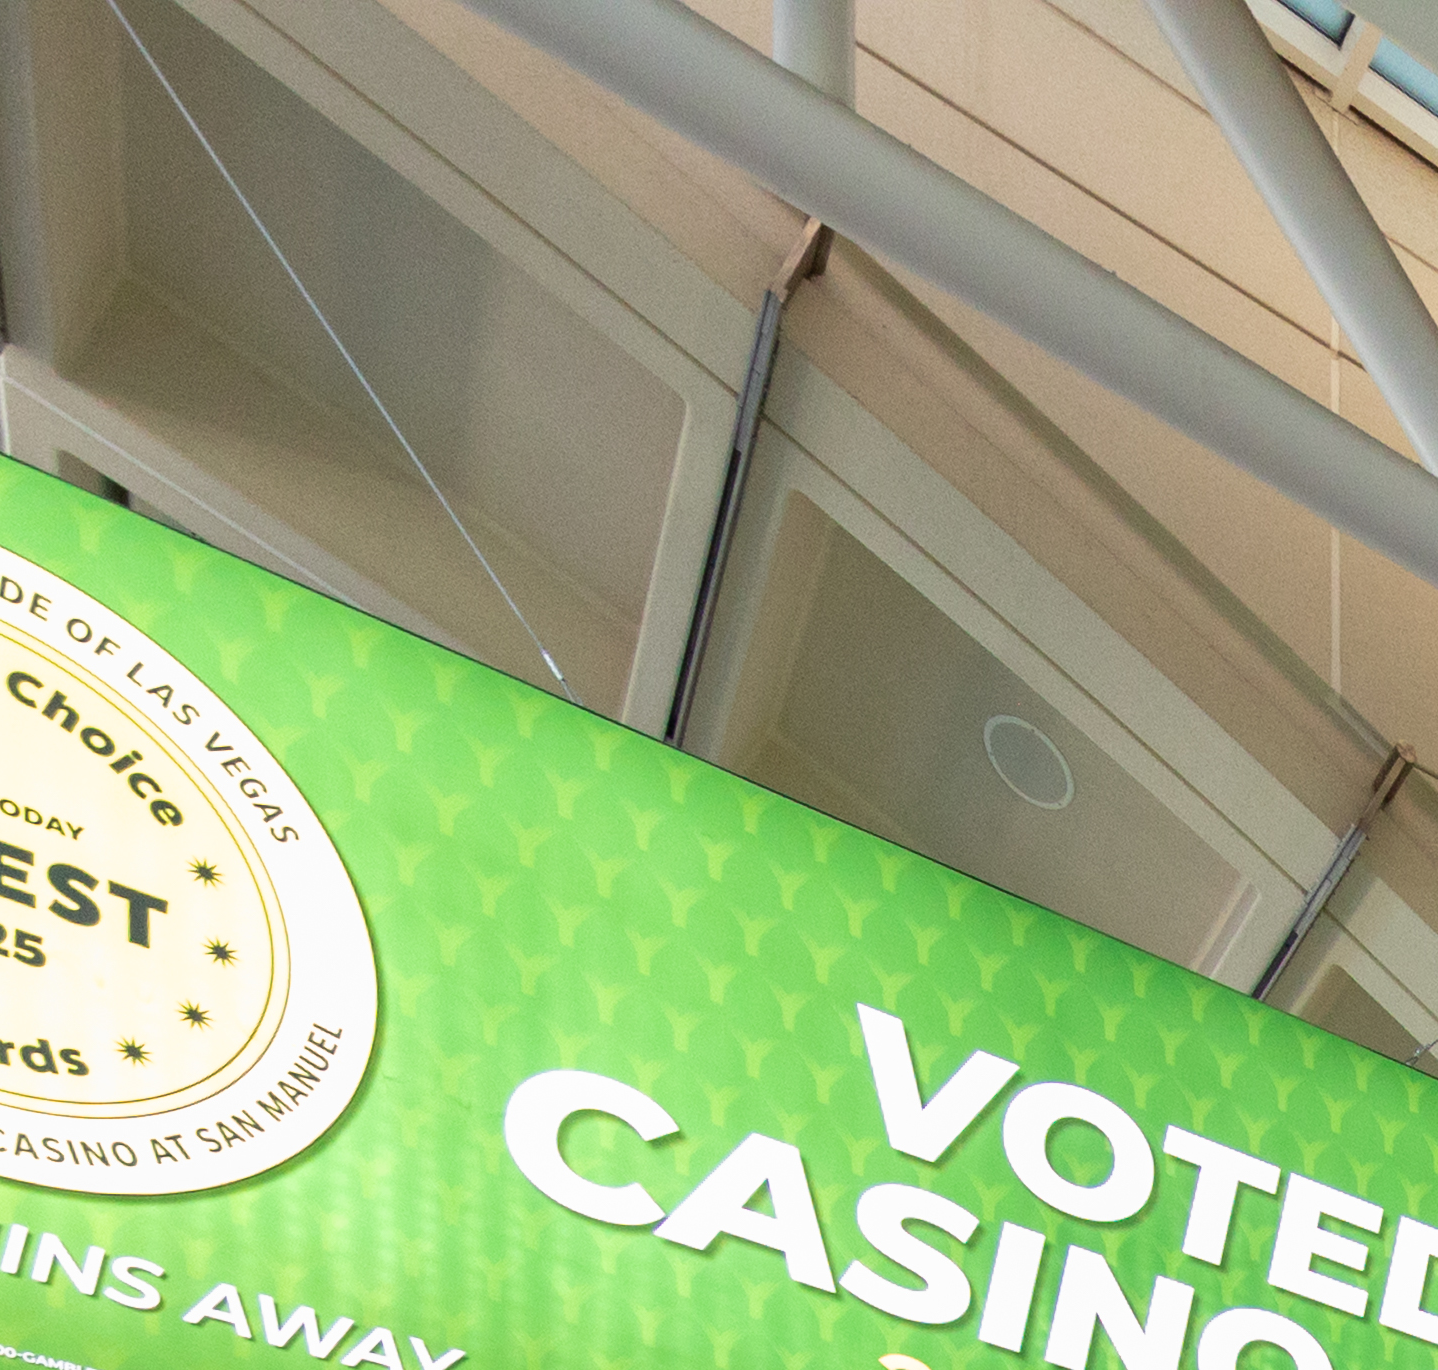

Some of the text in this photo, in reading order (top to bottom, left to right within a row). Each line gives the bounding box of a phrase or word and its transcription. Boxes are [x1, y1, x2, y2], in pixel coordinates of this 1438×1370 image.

[6, 670, 184, 827] Choice
[66, 618, 121, 657] OF
[126, 661, 200, 725] LAS
[205, 731, 299, 843] VEGAS
[150, 1133, 191, 1165] AT
[195, 1108, 266, 1154] SAN
[257, 1022, 343, 1123] MANUEL
